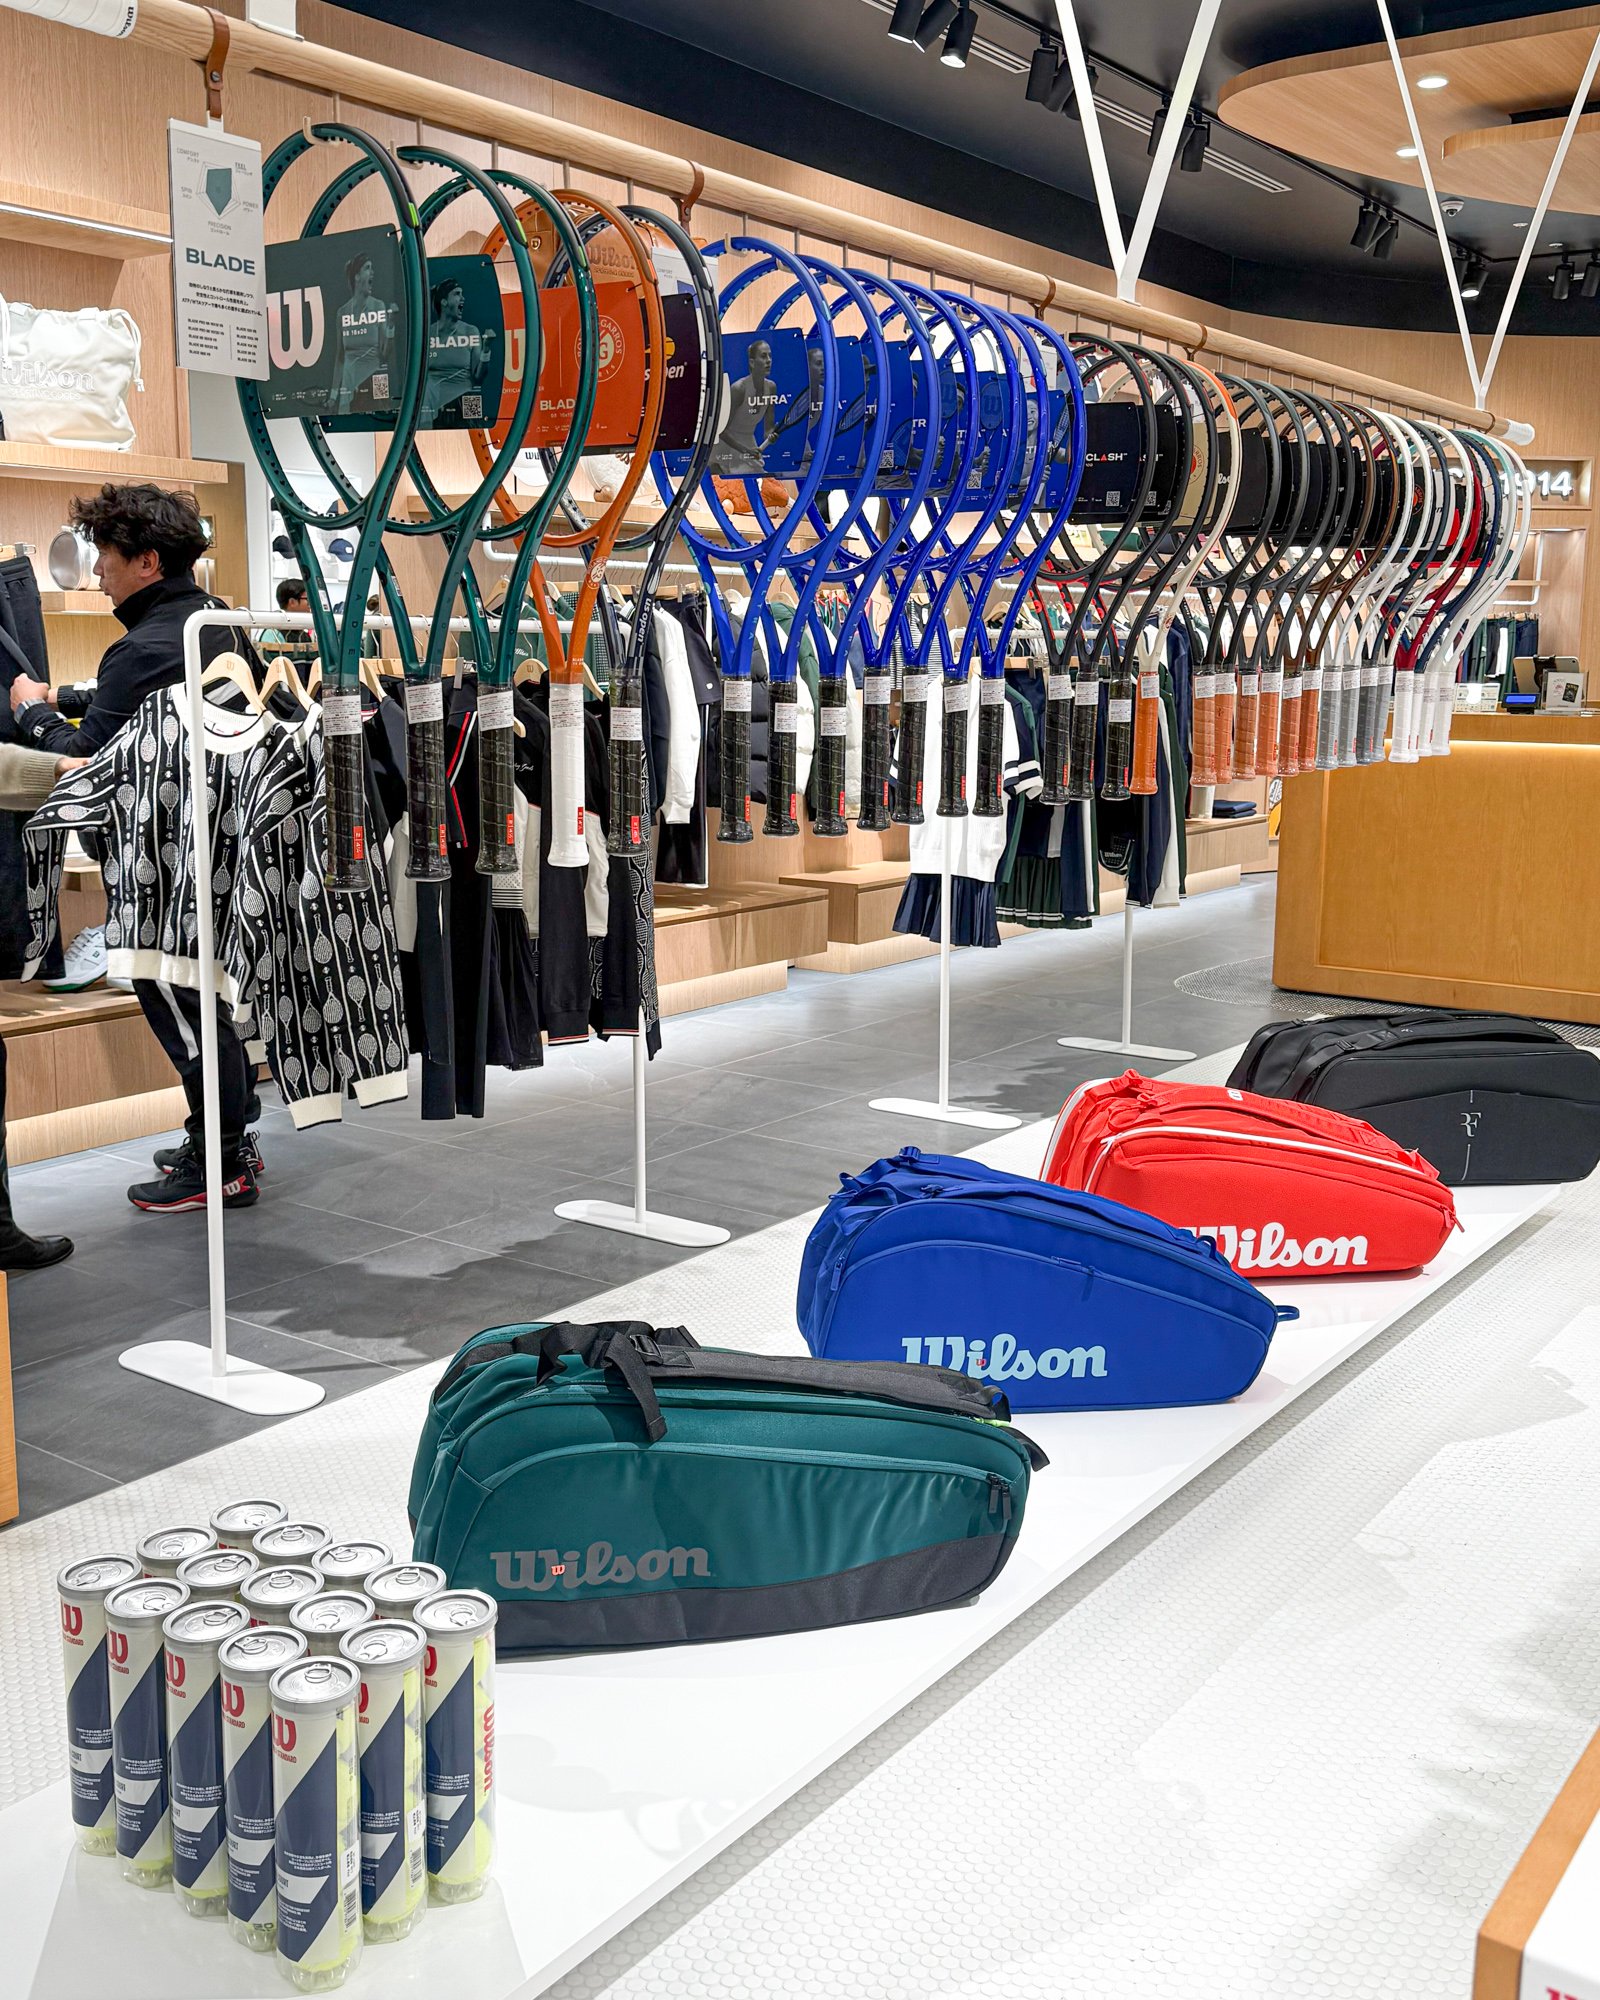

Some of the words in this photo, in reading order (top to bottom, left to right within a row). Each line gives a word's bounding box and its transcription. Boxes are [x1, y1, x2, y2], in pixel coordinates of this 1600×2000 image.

[186, 248, 255, 275] BLADE
[342, 310, 386, 327] BLADE
[600, 319, 622, 354] GARROS
[540, 398, 577, 411] BLAD
[748, 395, 787, 406] ULTRA
[1086, 453, 1123, 462] CLASH
[1499, 470, 1574, 497] 1914
[1460, 1112, 1482, 1137] RF
[902, 1333, 1108, 1381] Wilson
[490, 1541, 711, 1592] Wilson
